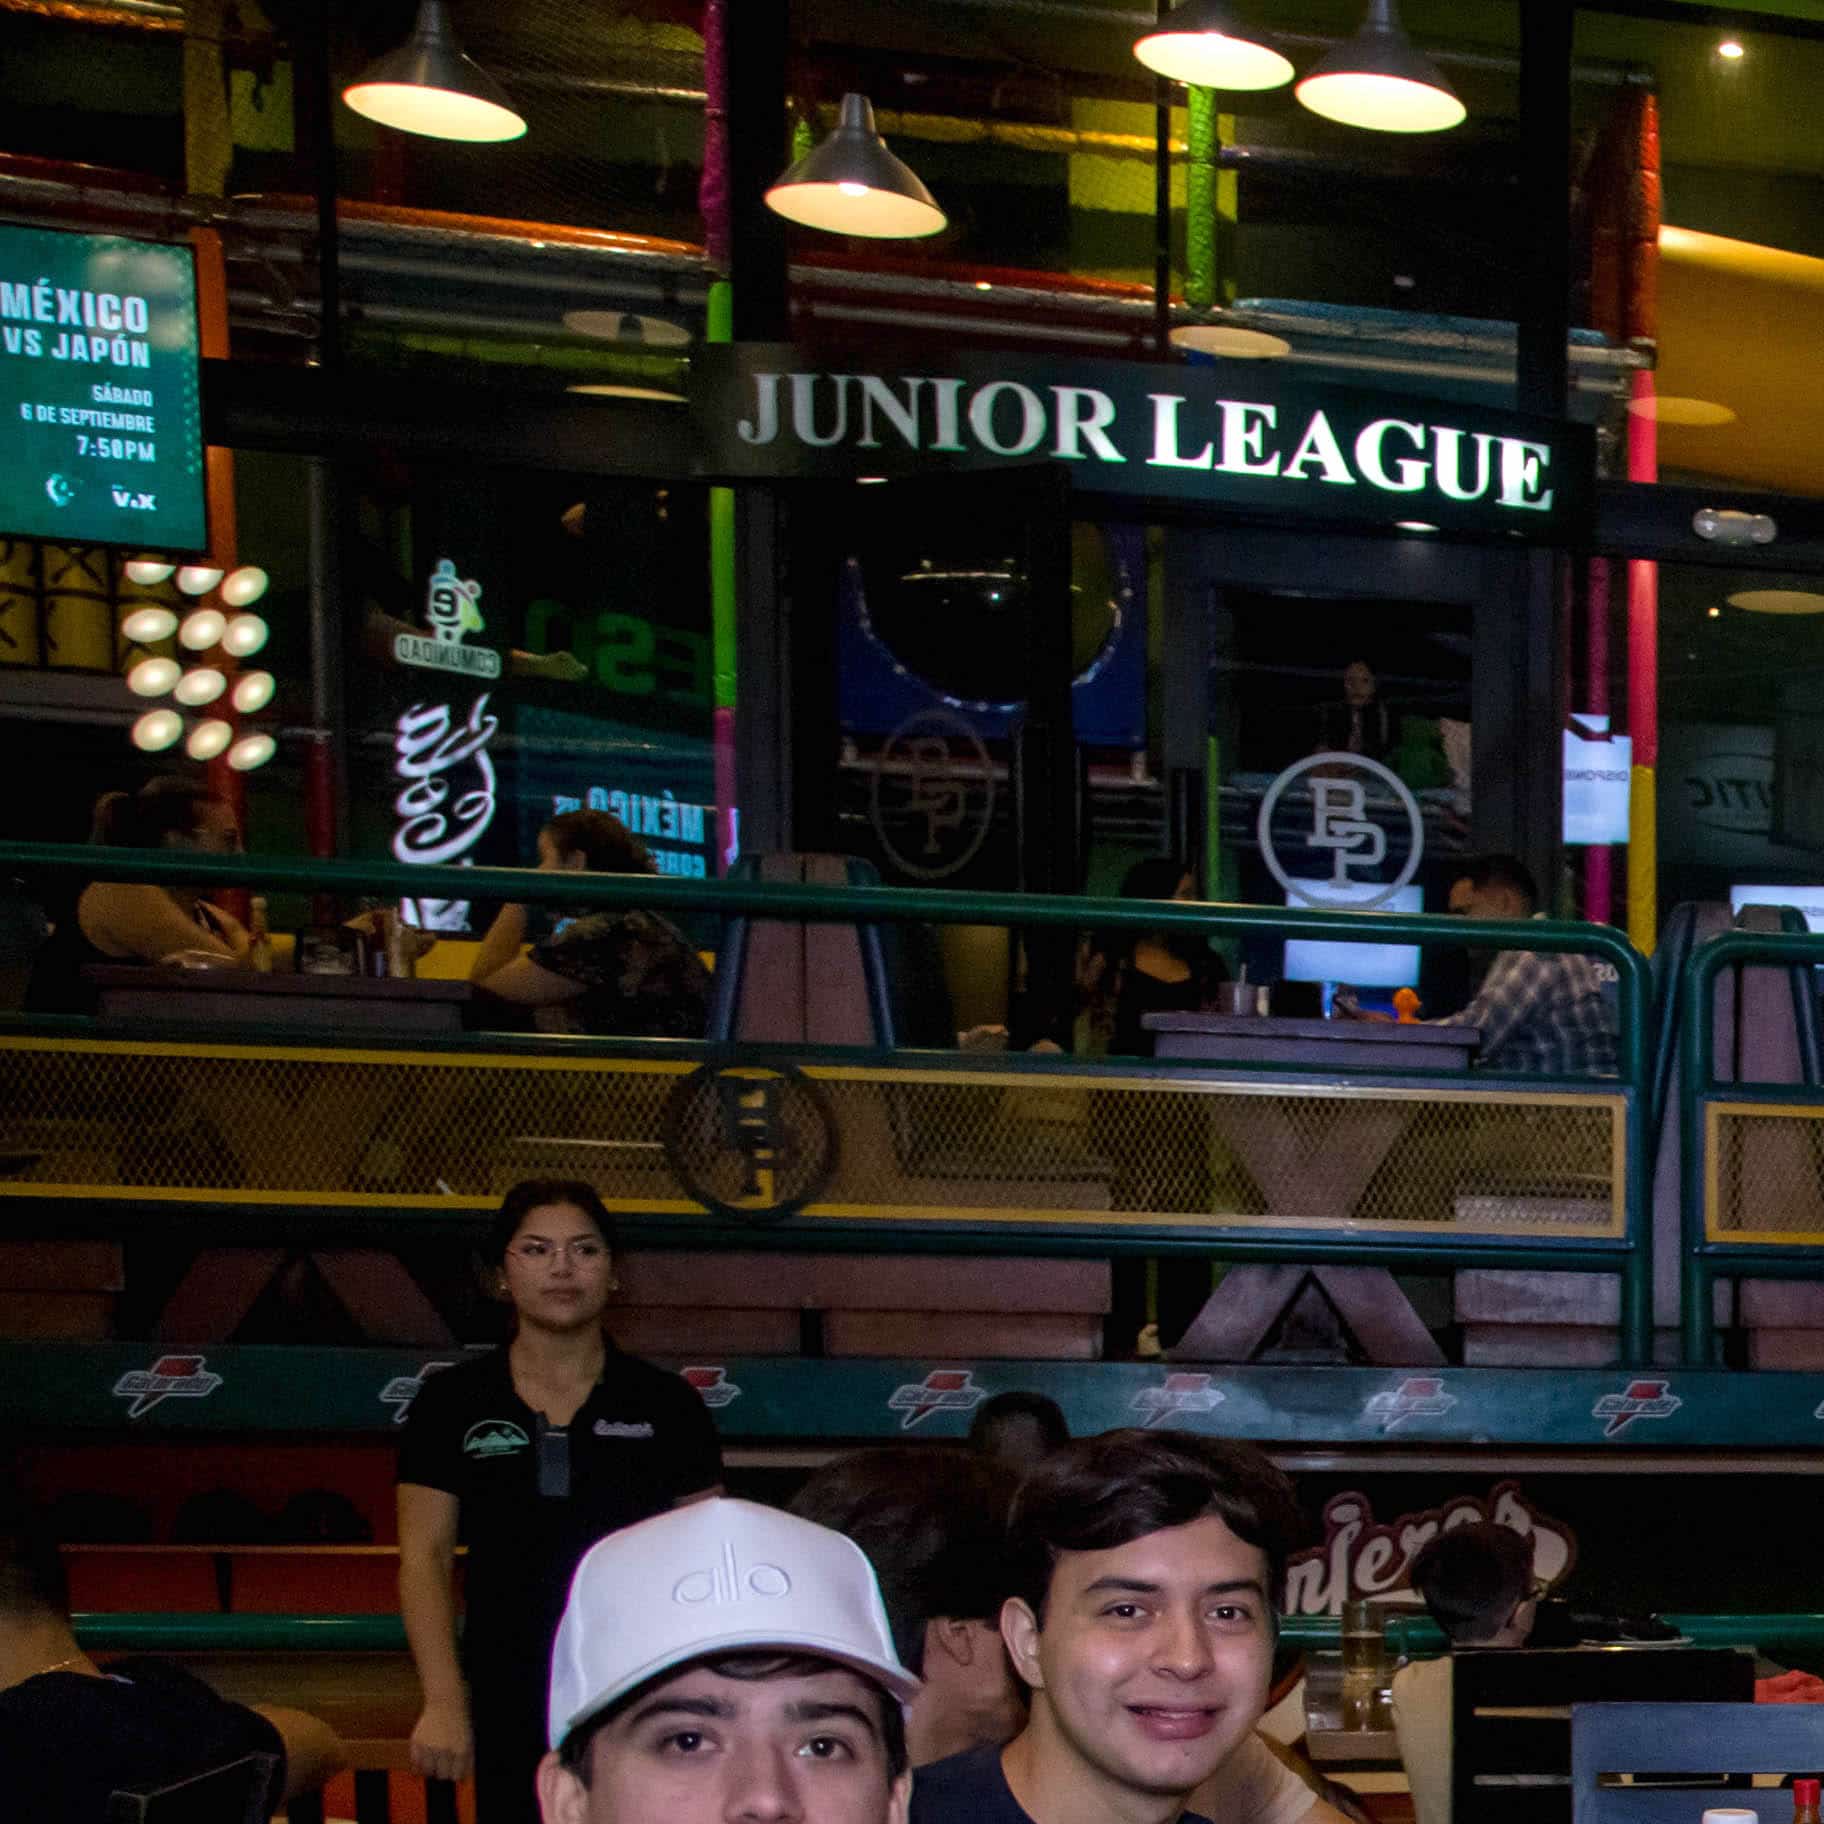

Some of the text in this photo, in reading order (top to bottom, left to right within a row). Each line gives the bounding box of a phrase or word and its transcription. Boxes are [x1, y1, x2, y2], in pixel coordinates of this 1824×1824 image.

[0, 277, 149, 334] MÉXICO
[2, 326, 150, 369] VS JAPÓN
[20, 402, 156, 433] 6 DE SEPTIEMBRE
[91, 381, 153, 408] SÁBADO
[737, 372, 1555, 511] JUNIOR LEAGUE
[671, 1535, 793, 1607] alo
